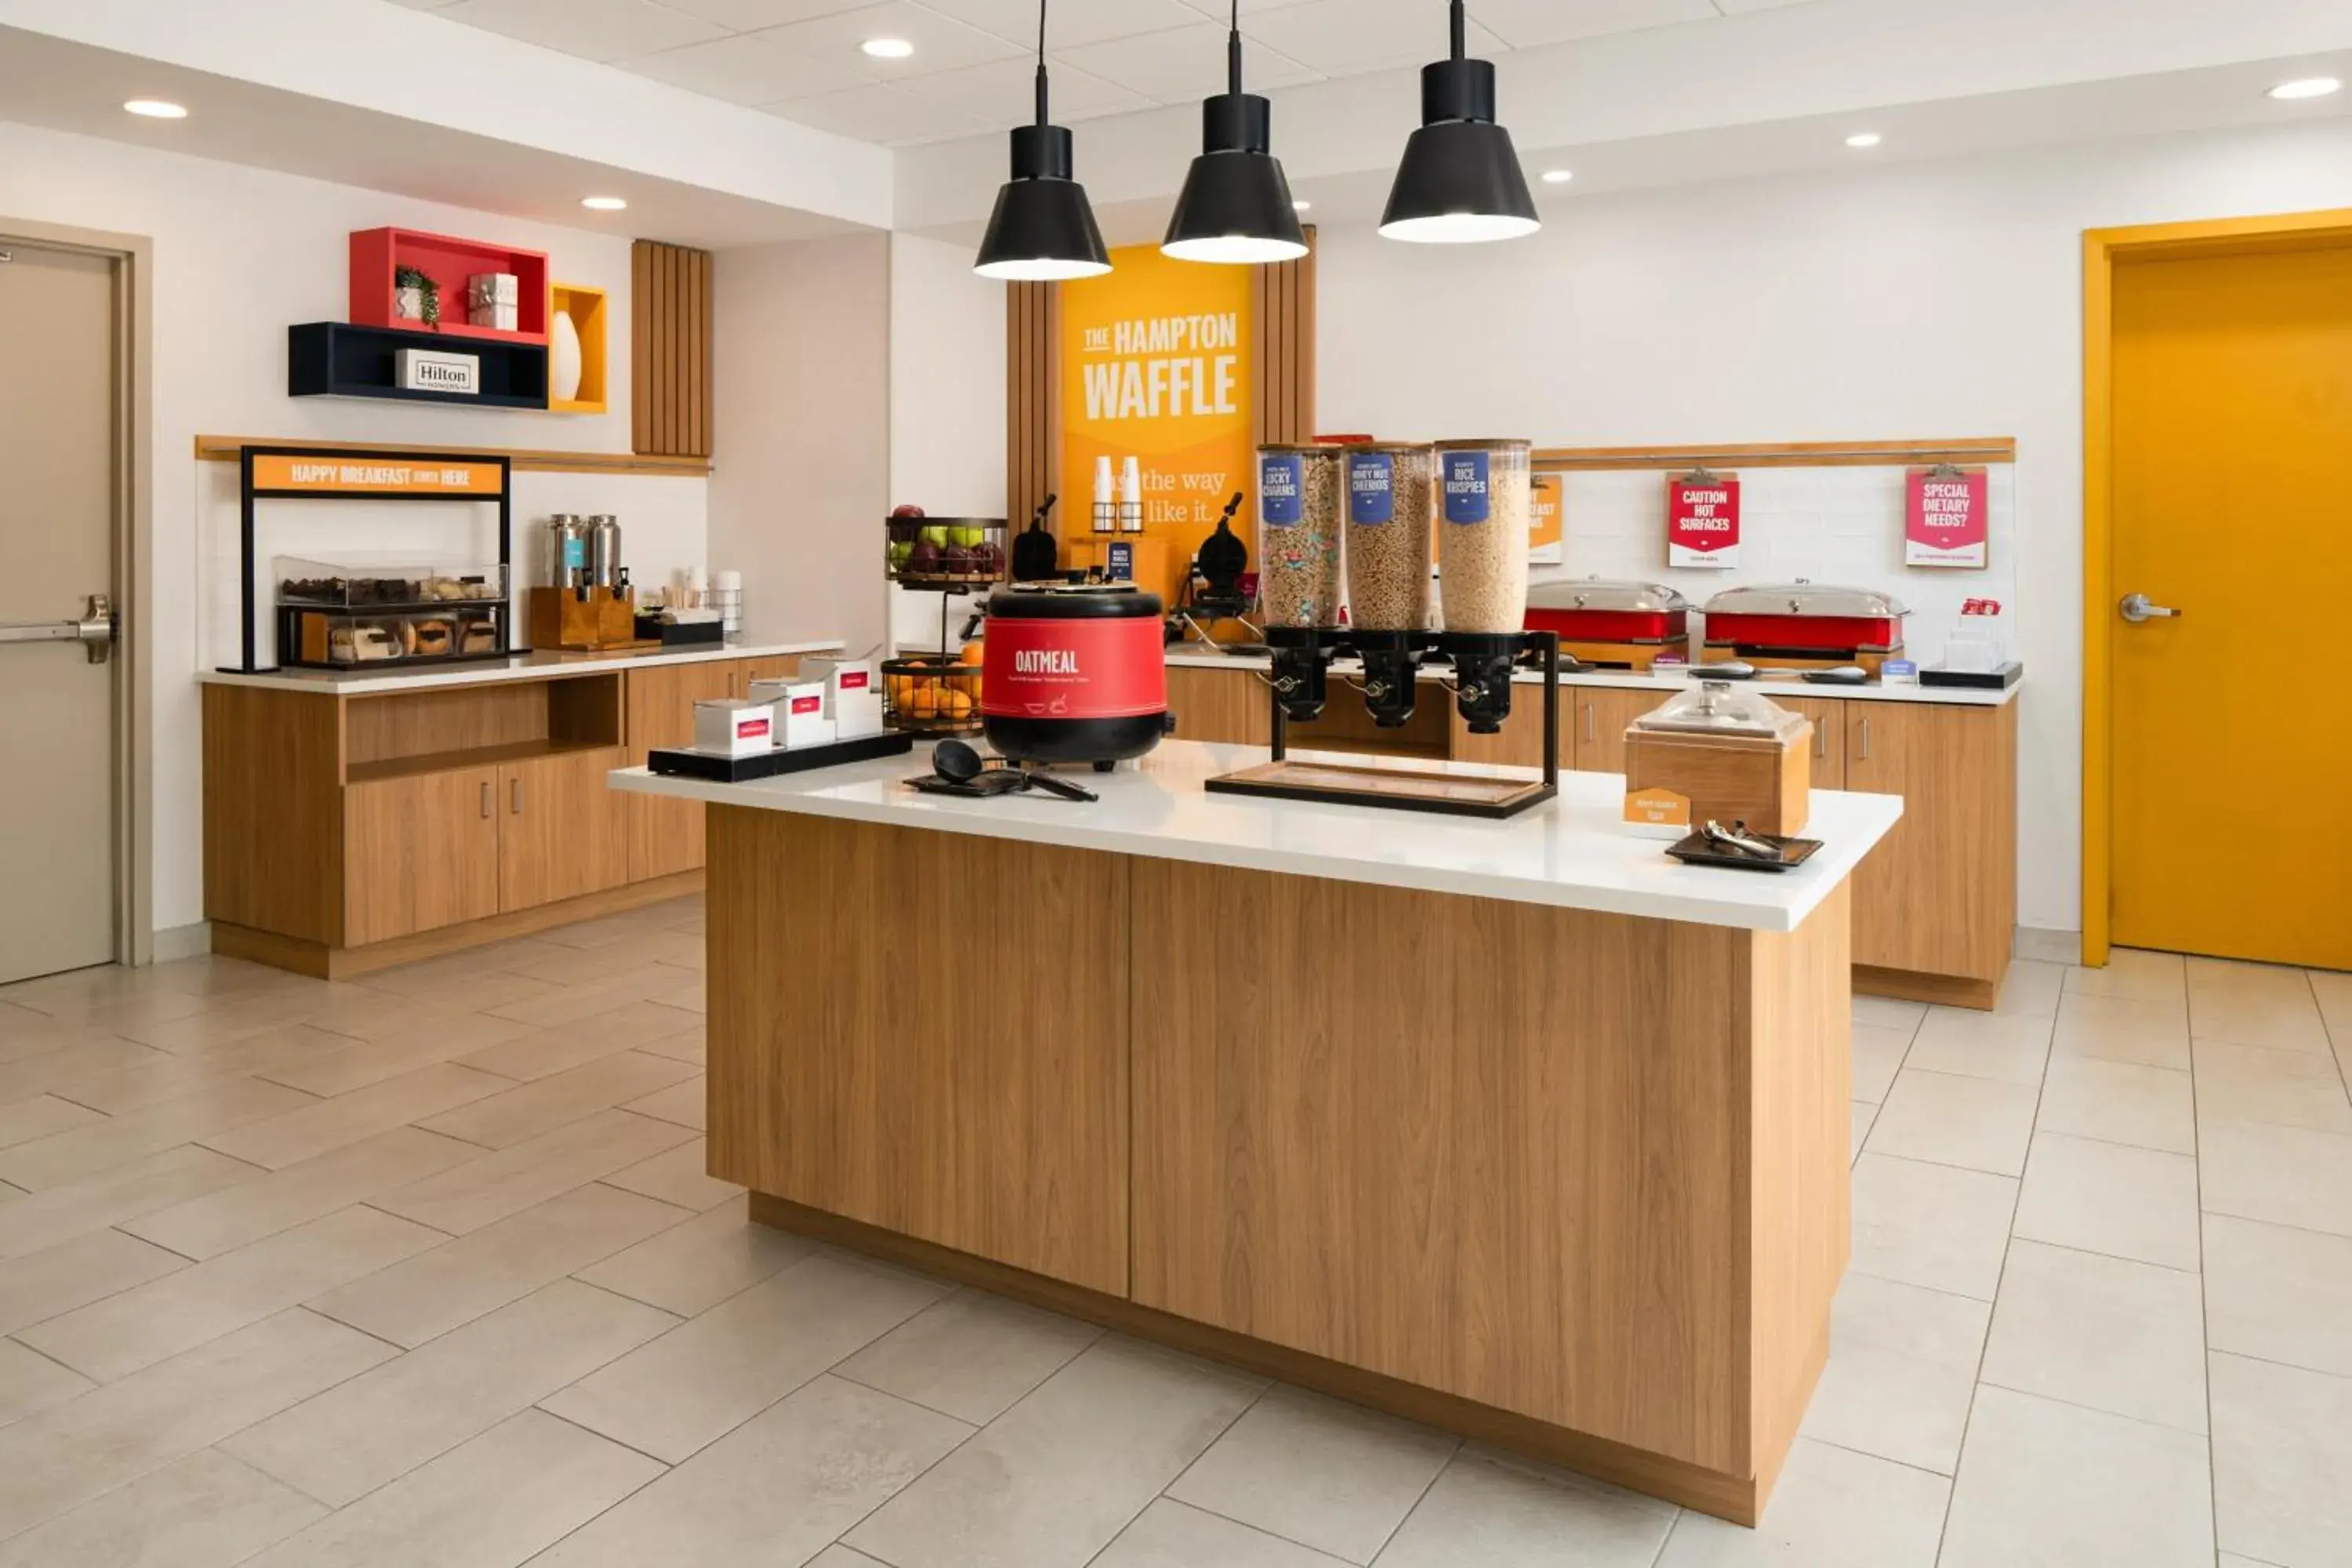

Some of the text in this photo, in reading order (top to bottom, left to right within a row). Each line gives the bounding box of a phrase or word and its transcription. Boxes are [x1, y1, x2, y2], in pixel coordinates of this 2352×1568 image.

[1084, 312, 1237, 354] THE HAMPTON
[420, 365, 466, 383] Hilton
[1083, 354, 1237, 420] WAFFLE
[292, 463, 337, 484] HAPPY
[340, 465, 412, 486] BREAKFAST
[441, 468, 470, 487] HERE
[1266, 471, 1291, 485] LUCKY
[1454, 468, 1475, 481] RICE
[1142, 469, 1176, 491] the
[1181, 472, 1227, 496] way
[1446, 481, 1486, 493] KRISPIES
[1682, 490, 1728, 504] CAUTION
[1923, 483, 1970, 498] SPECIAL
[1148, 499, 1214, 522] like it.
[1694, 504, 1715, 517] HOT
[1922, 498, 1970, 512] DIETARY
[1679, 517, 1730, 532] SURFACES
[1925, 513, 1968, 528] NEEDS?
[1015, 649, 1080, 673] OATMEAL
